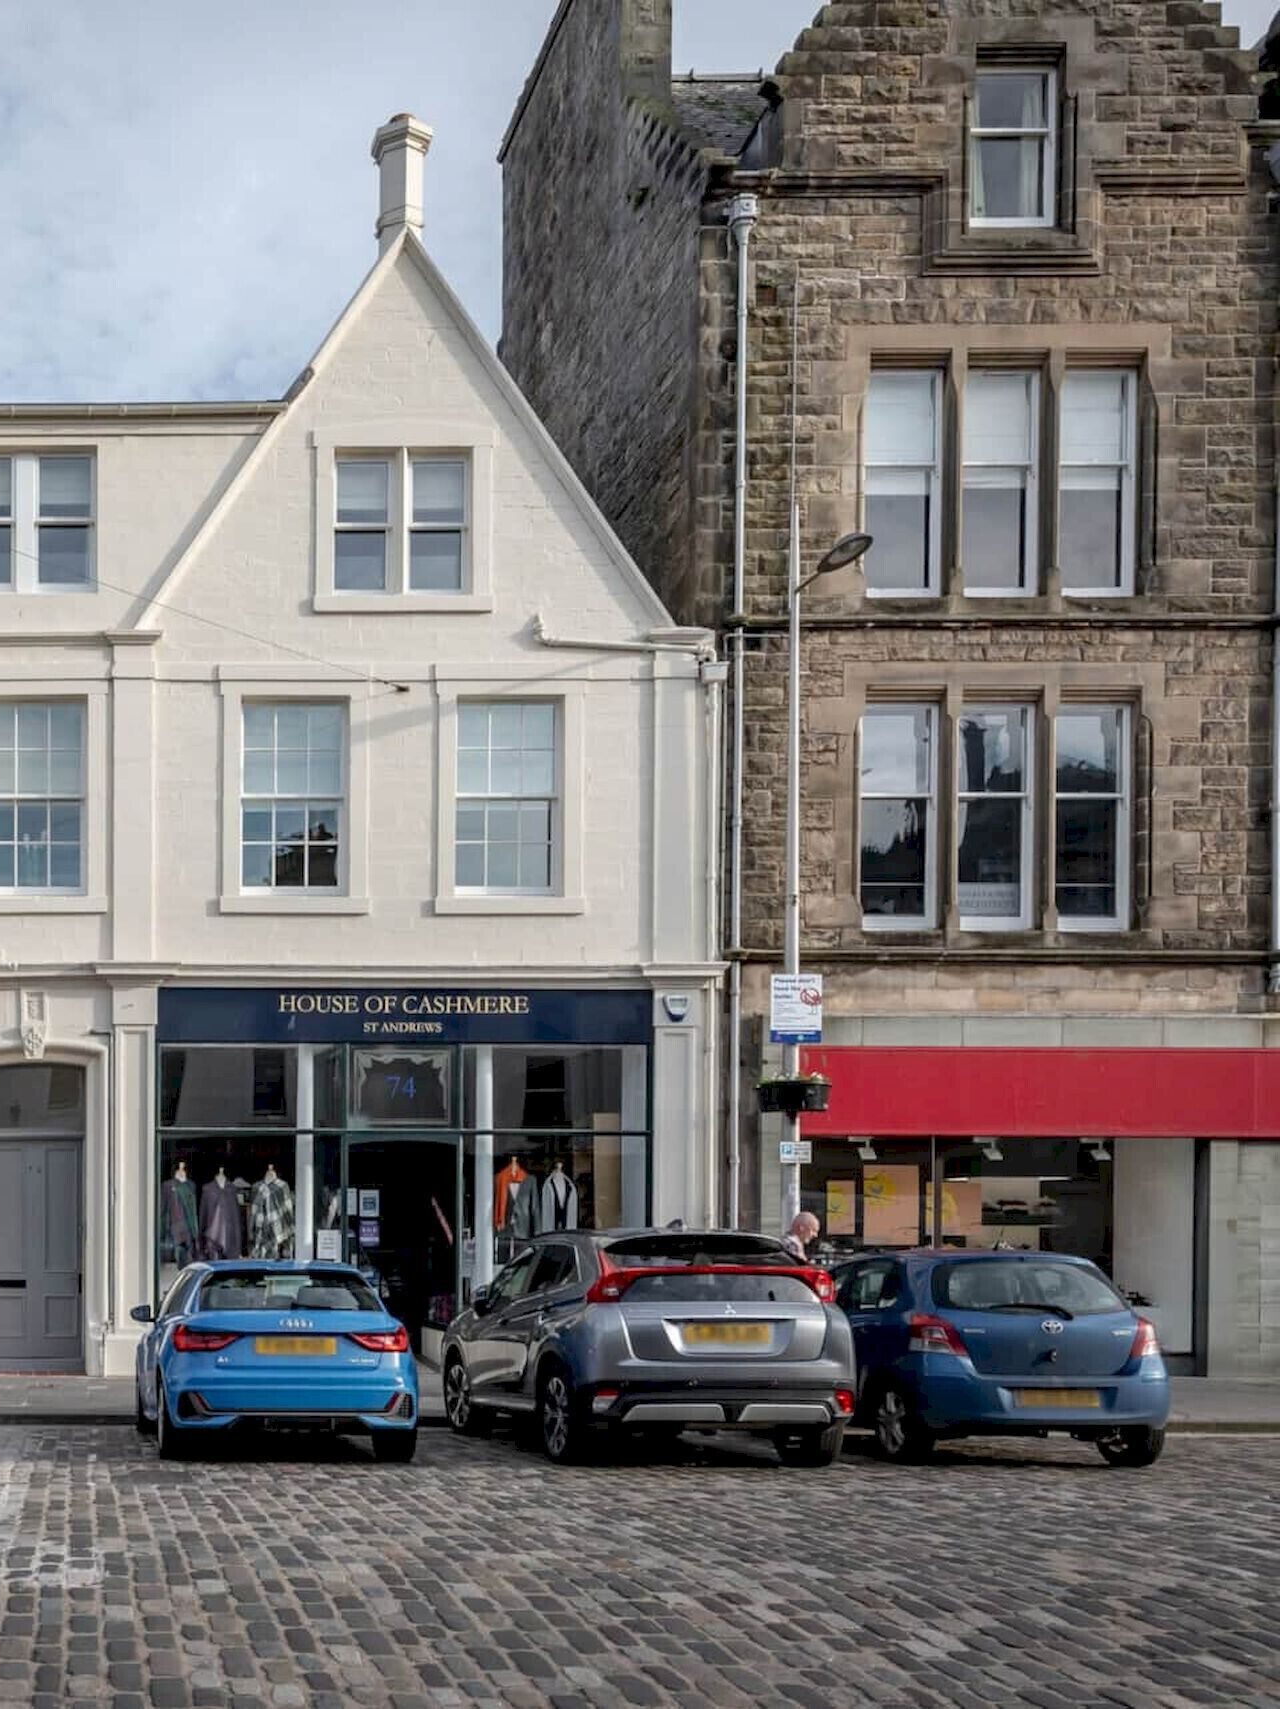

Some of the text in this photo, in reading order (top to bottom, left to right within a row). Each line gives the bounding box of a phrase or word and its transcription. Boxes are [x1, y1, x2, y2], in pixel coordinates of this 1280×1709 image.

[278, 994, 530, 1015] HOUSE OF CASHMERE
[363, 1021, 444, 1033] ST ANDREWS
[383, 1075, 417, 1099] 74
